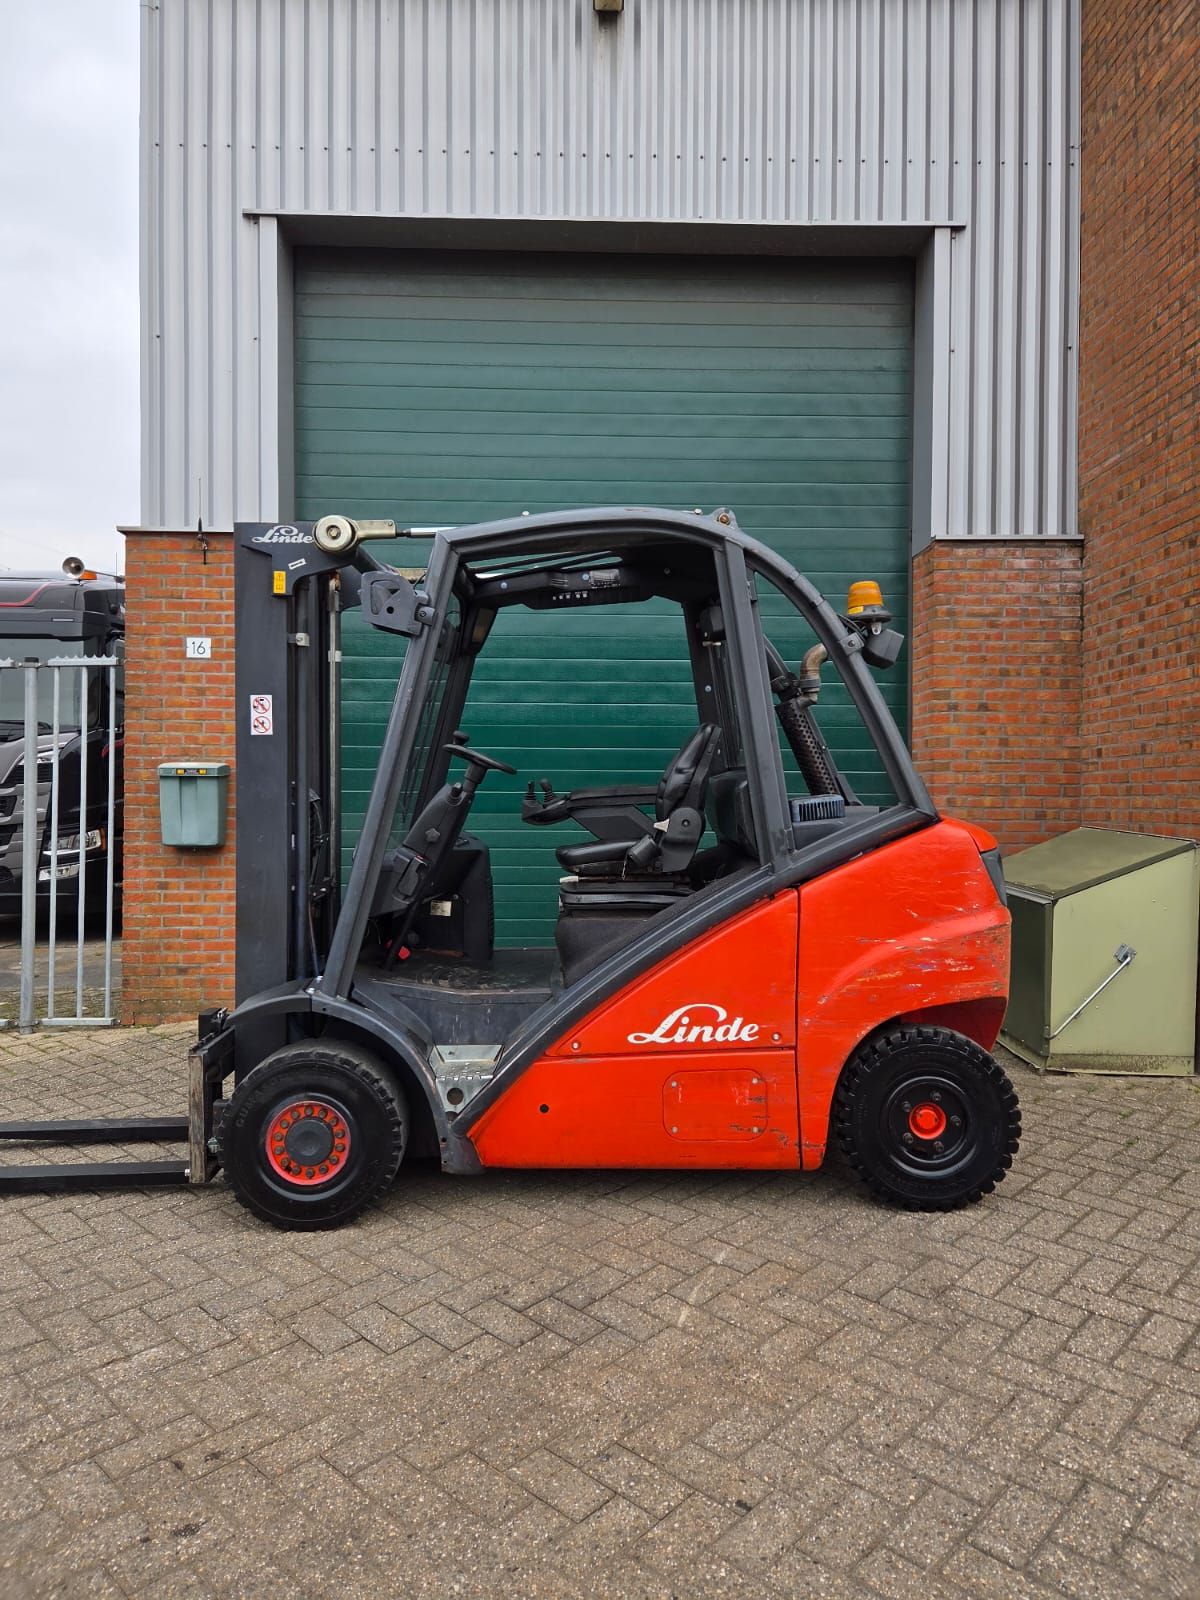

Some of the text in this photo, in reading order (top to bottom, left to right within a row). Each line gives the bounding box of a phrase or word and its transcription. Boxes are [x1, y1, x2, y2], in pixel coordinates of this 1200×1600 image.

[252, 525, 314, 543] Linde
[191, 640, 206, 655] 16
[627, 1003, 759, 1044] Linde
